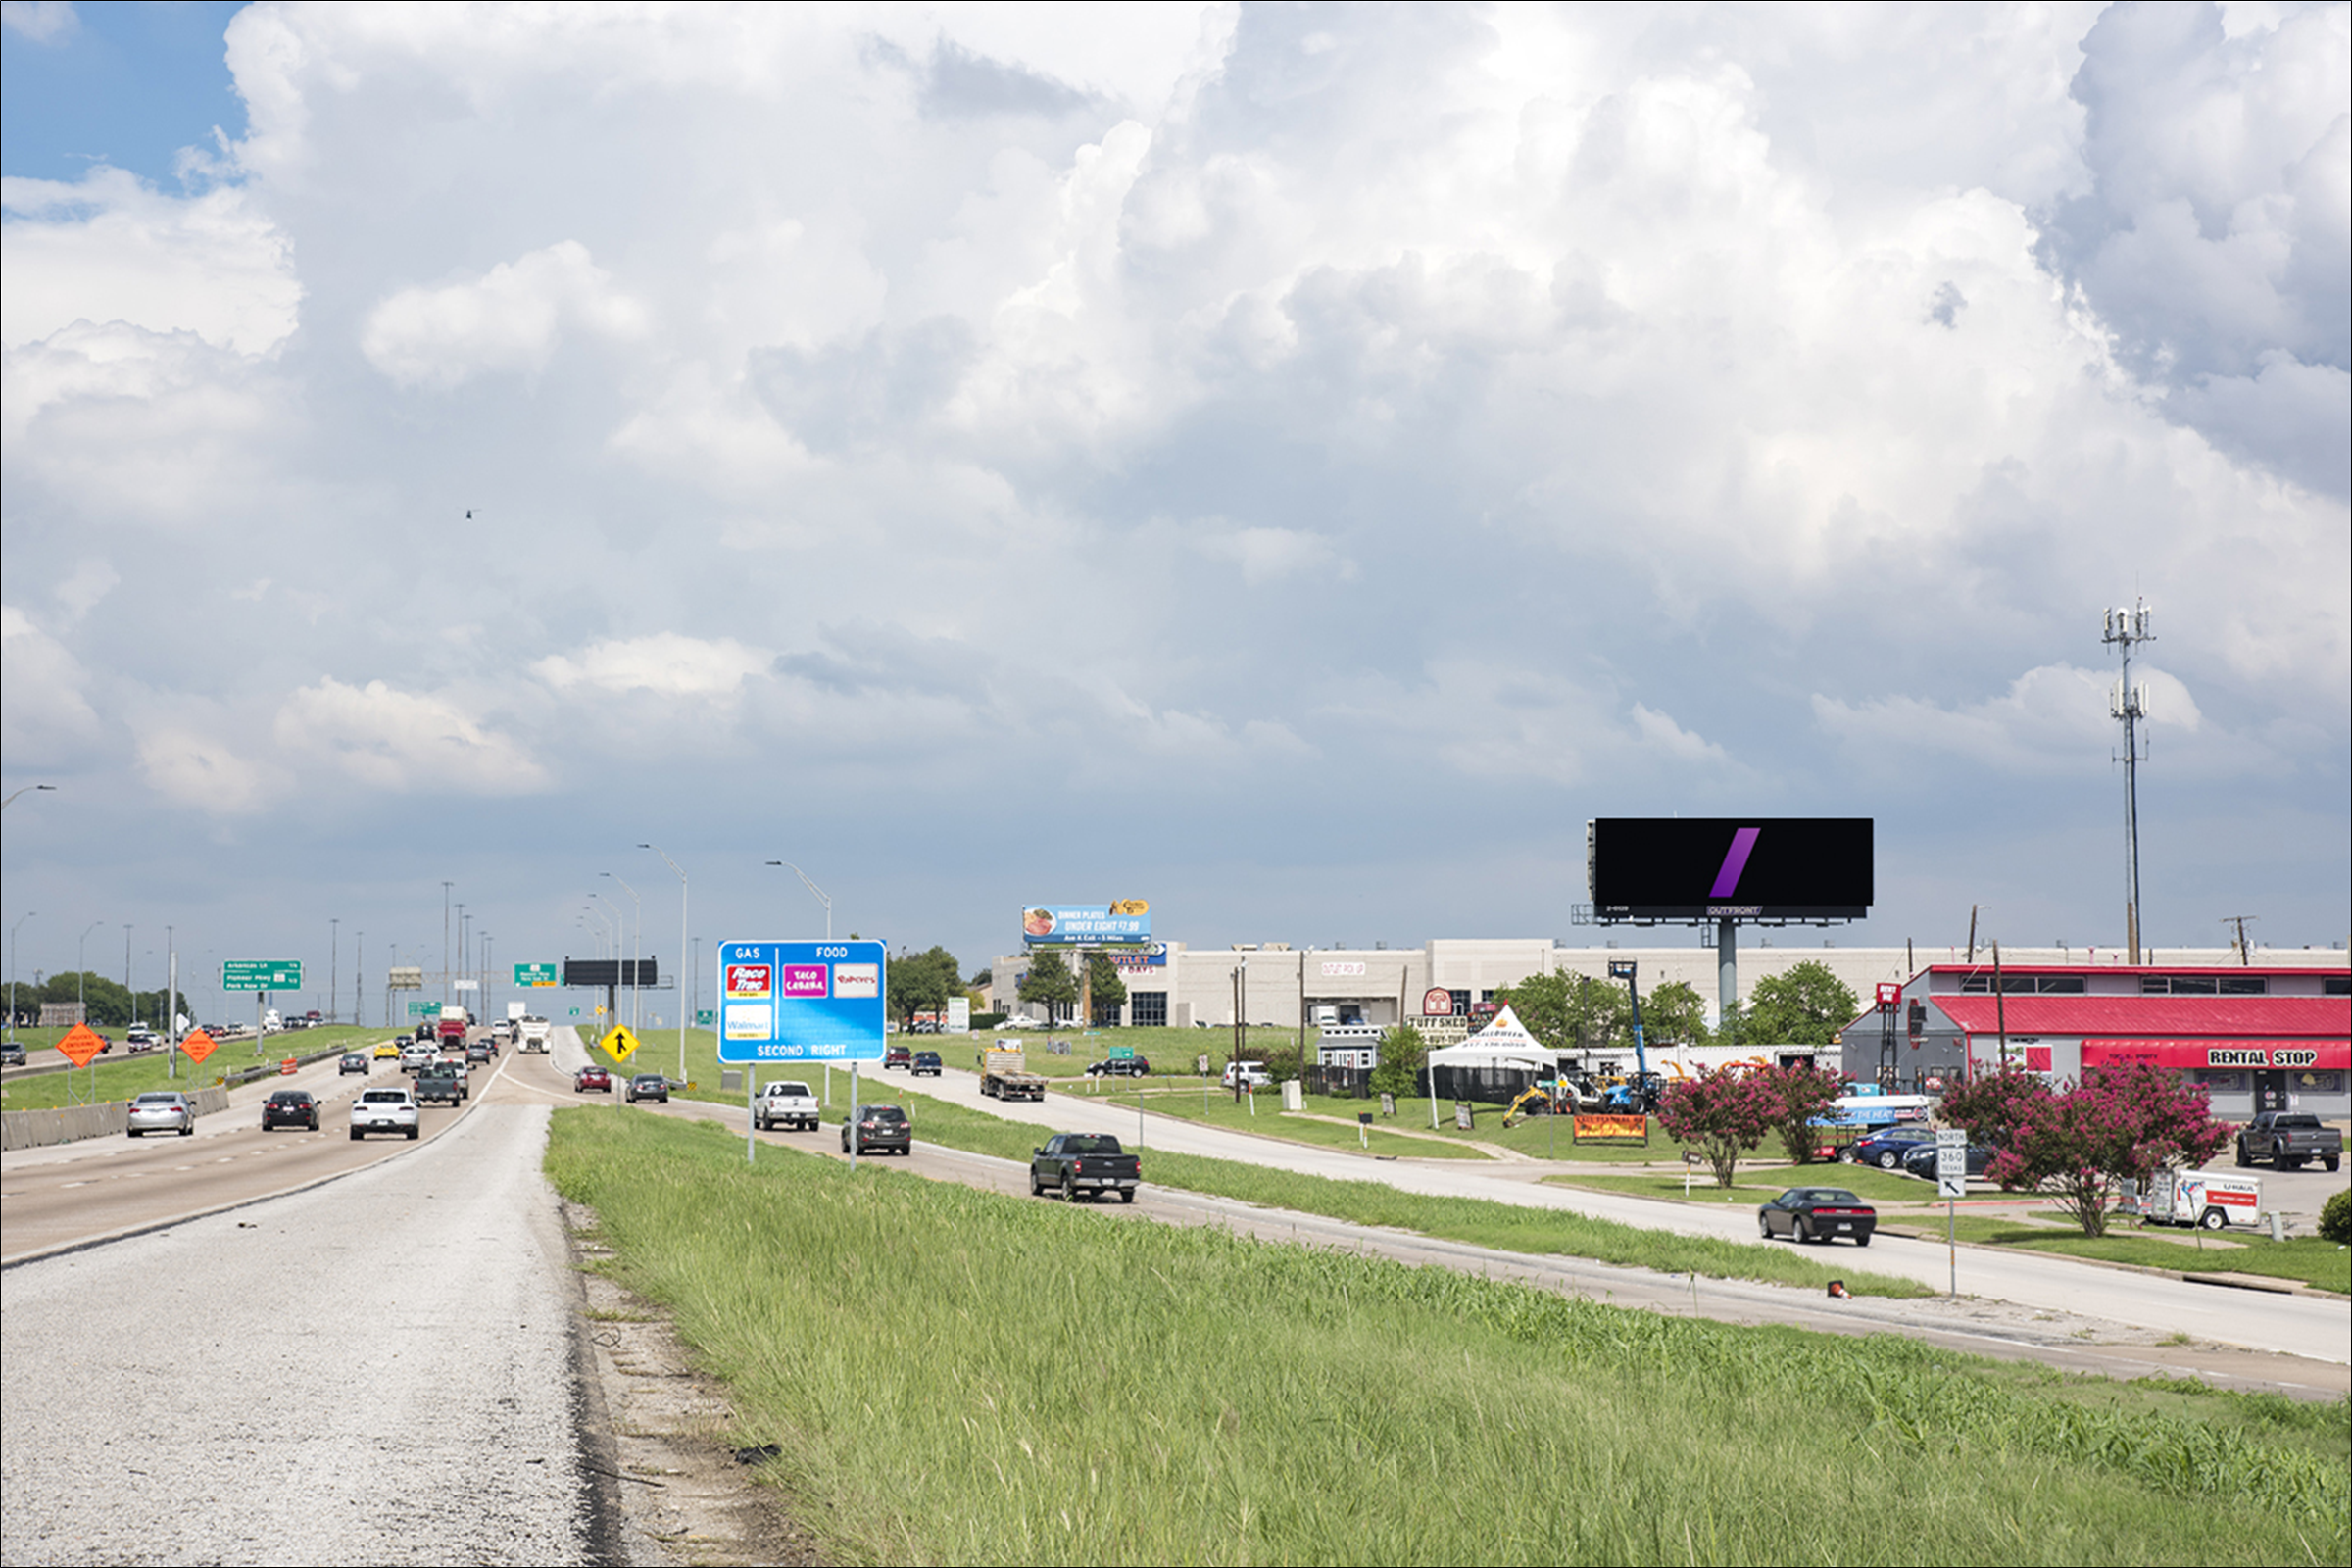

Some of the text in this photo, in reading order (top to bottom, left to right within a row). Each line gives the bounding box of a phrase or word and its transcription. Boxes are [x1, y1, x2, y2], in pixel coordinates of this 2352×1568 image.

[1708, 906, 1760, 915] OUTFRONT
[1065, 921, 1093, 931] UNDER
[1094, 921, 1117, 931] EIGHT
[736, 947, 760, 958] GAS
[816, 947, 848, 958] FOOD
[732, 967, 767, 979] Race
[794, 971, 817, 980] TACO
[735, 979, 763, 991] Trac
[786, 981, 824, 990] CABANA
[727, 1021, 769, 1030] Walmart
[1408, 1018, 1439, 1028] TUFF
[1439, 1018, 1466, 1028] SHED
[758, 1044, 847, 1056] SECOND RIGHT
[2208, 1049, 2317, 1066] RENTAL STOP
[1938, 1132, 1965, 1142] NORTH
[1941, 1151, 1963, 1162] 360
